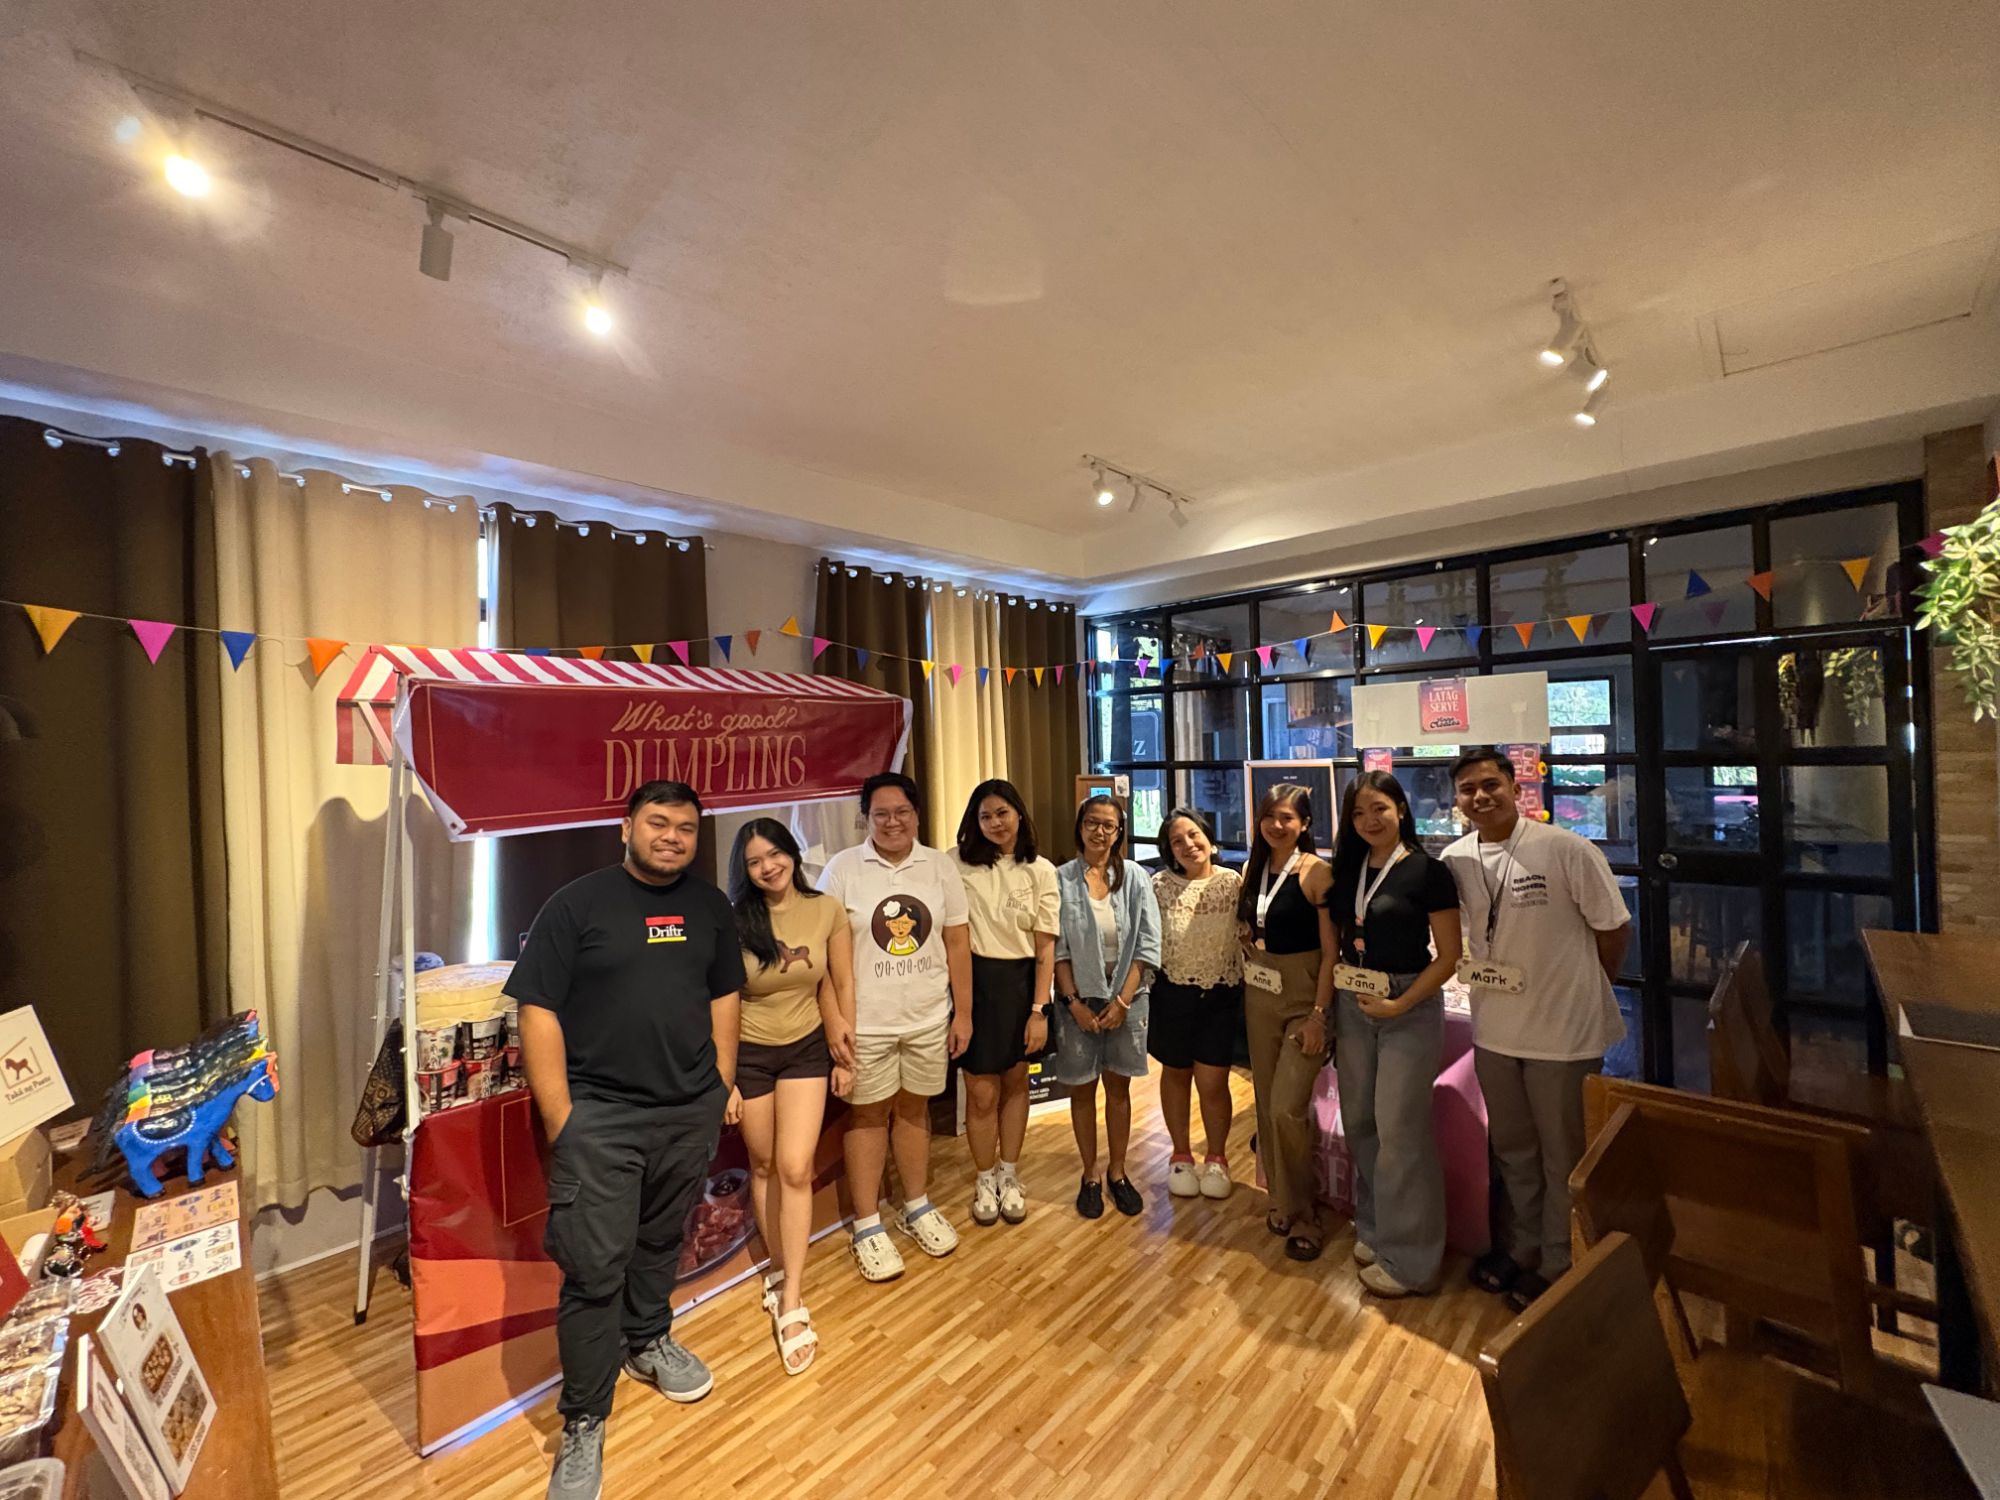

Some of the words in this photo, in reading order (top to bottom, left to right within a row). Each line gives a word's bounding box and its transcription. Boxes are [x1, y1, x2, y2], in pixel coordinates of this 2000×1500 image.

[1429, 690, 1459, 702] LATAG
[611, 700, 713, 733] What's
[720, 704, 799, 745] good?
[603, 733, 806, 801] DUMPLING
[1513, 874, 1546, 884] REACH
[1511, 882, 1547, 892] HIGHER
[648, 924, 684, 938] Driftr
[1345, 976, 1376, 990] Jana
[1470, 971, 1507, 985] Mark
